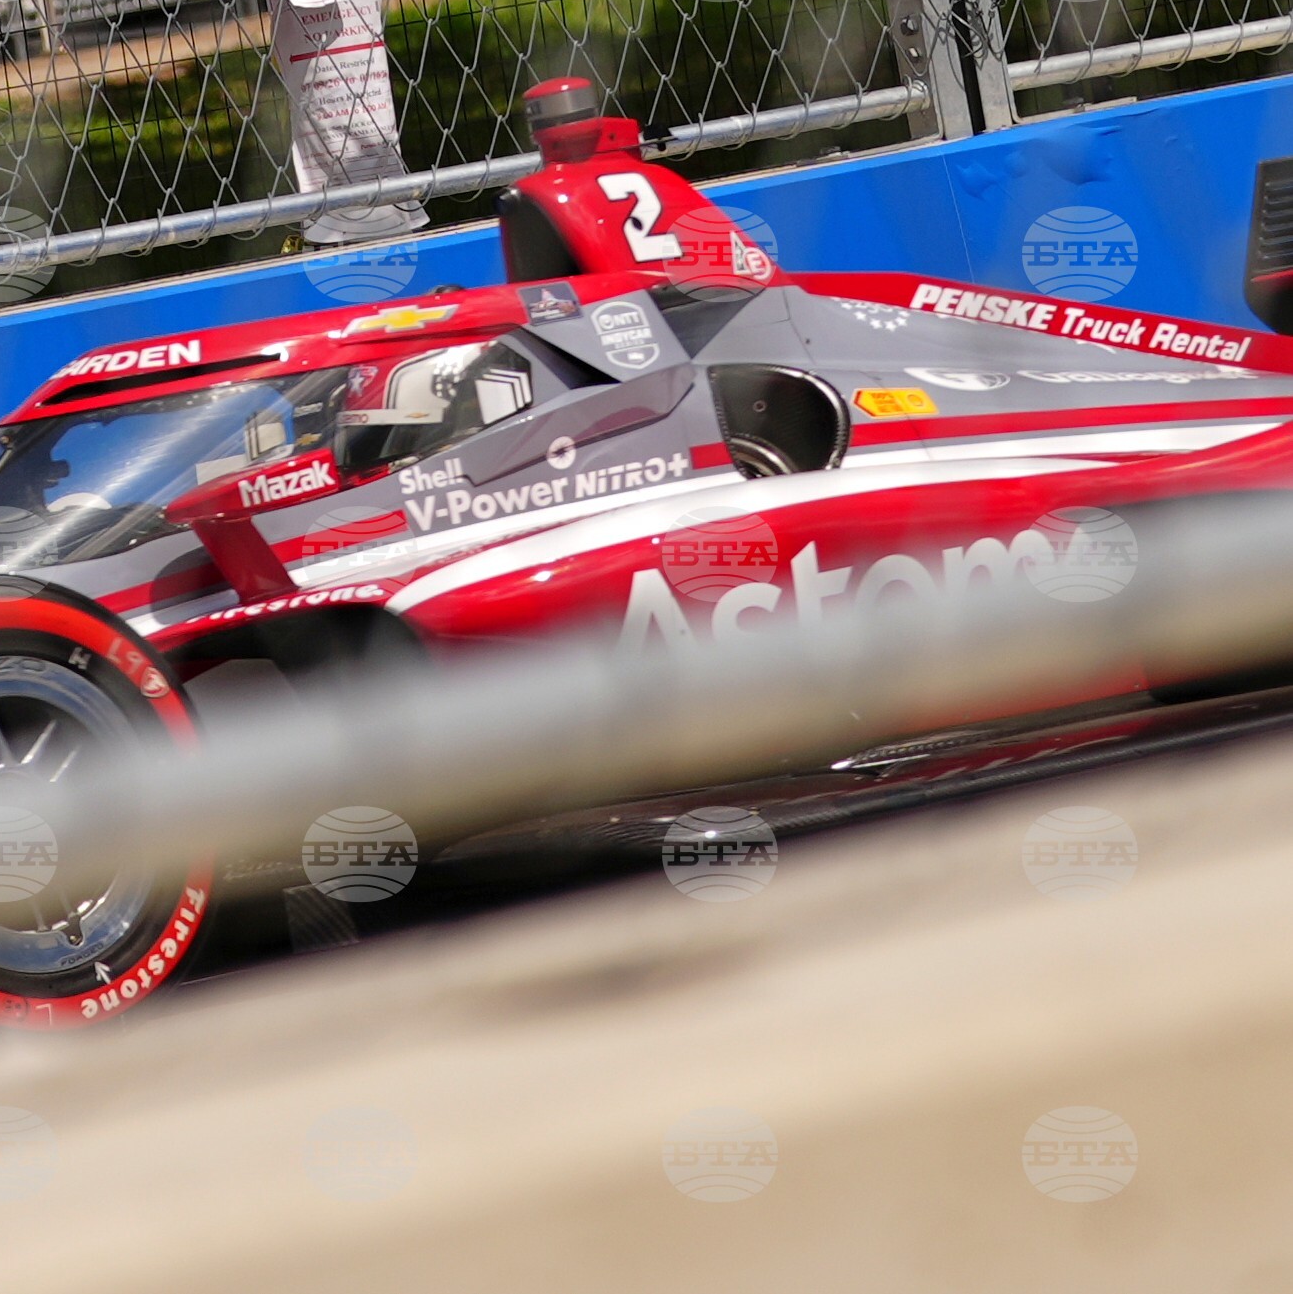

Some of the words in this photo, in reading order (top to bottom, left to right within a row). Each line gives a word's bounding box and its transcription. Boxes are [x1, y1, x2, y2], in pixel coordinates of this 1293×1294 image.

[301, 7, 372, 25] EMERGECY
[315, 64, 336, 74] Date
[595, 171, 684, 263] 2
[909, 282, 1058, 331] PENSKE
[1060, 306, 1147, 347] Truck
[1148, 321, 1253, 363] Rental
[237, 459, 336, 508] Mazak
[398, 457, 464, 495] Shell
[404, 474, 569, 532] V-Power
[80, 885, 206, 1021] Firestone
